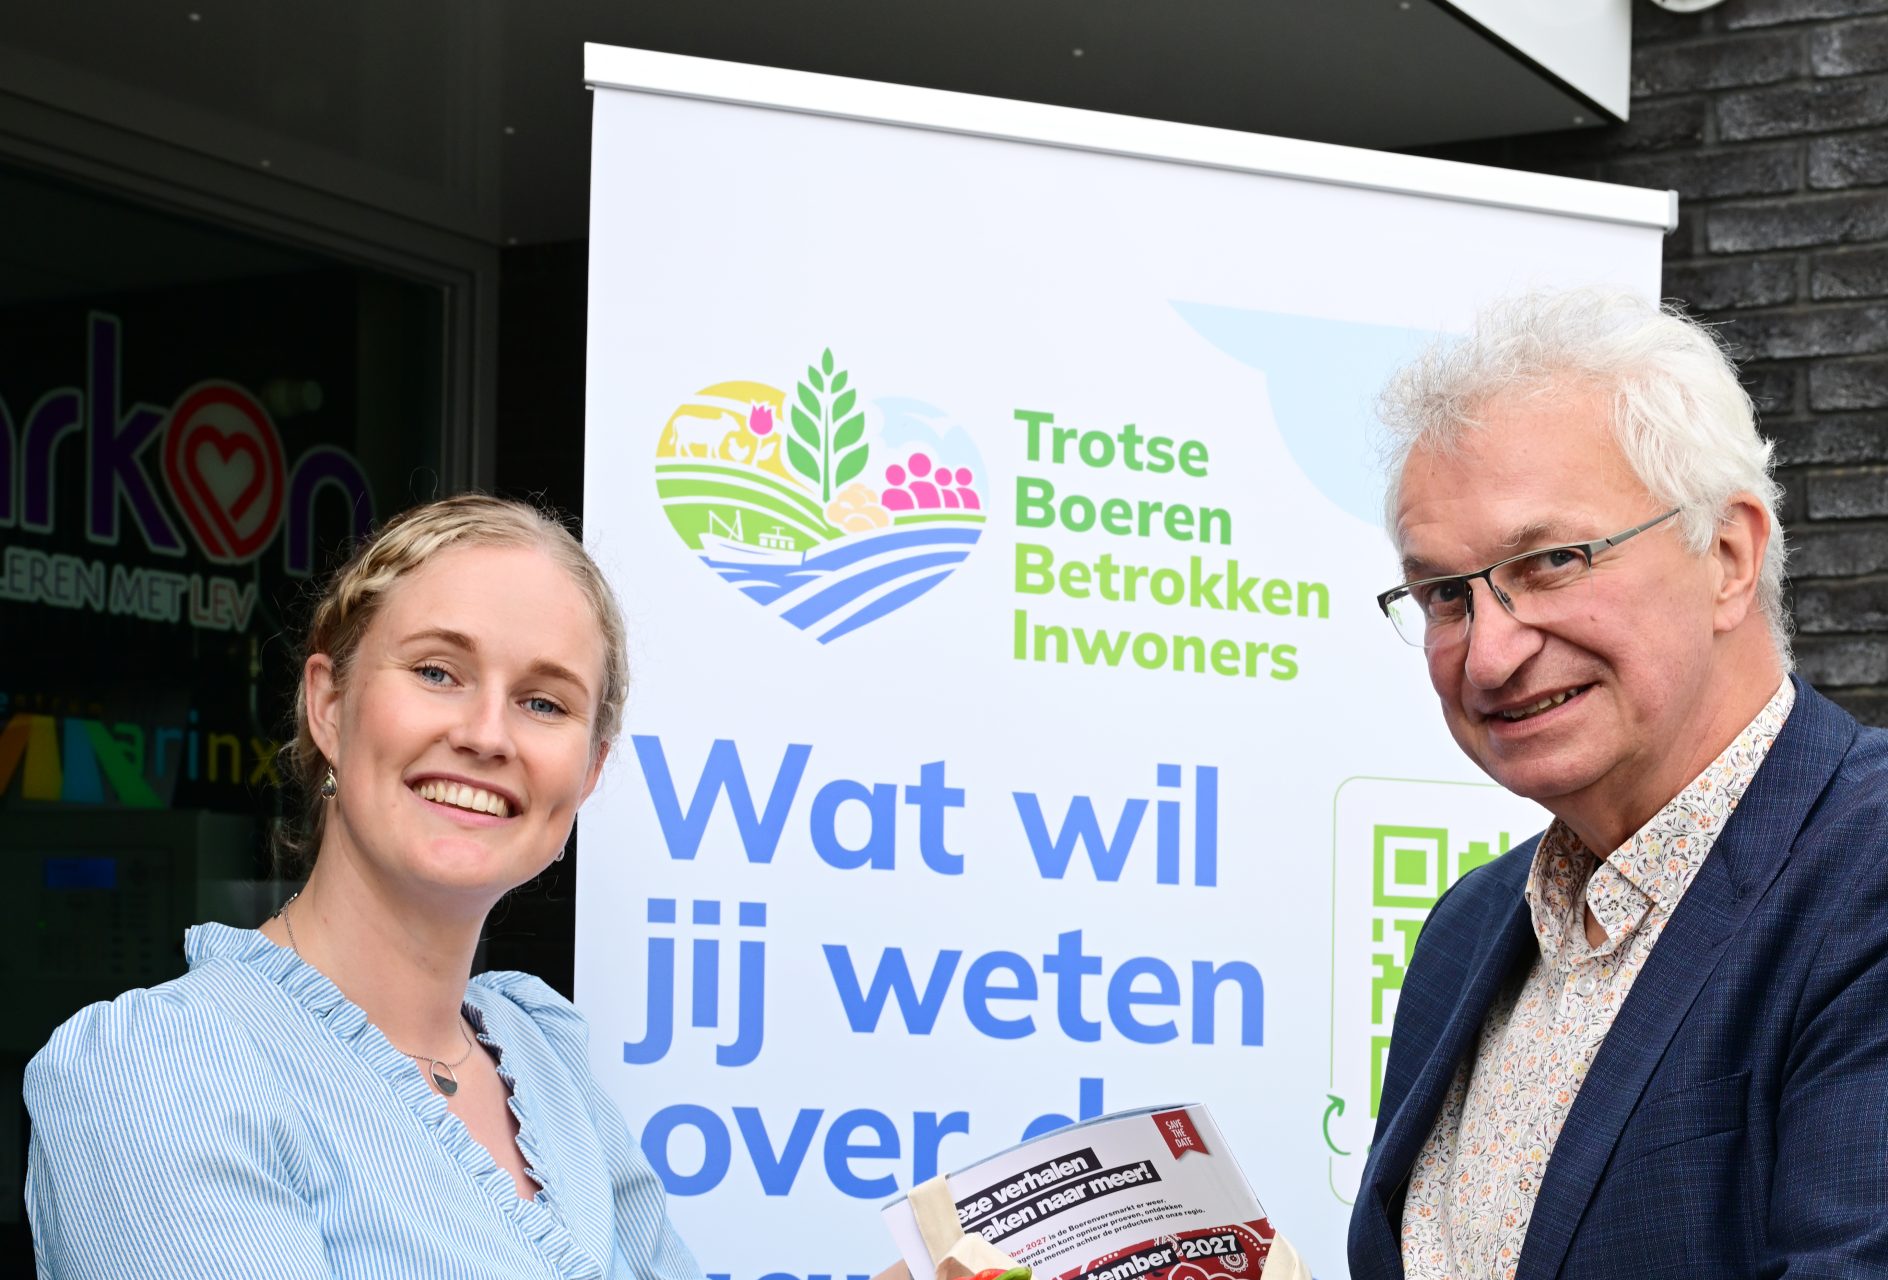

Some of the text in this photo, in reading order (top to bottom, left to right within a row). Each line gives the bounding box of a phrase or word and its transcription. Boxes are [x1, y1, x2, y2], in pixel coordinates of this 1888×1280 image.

[1015, 411, 1208, 477] Trotse
[1015, 477, 1231, 545] Boeren
[0, 550, 256, 630] EREN MET LEV
[1015, 544, 1329, 619] Betrokken
[1014, 609, 1298, 681] Inwoners
[632, 735, 1218, 887] Wat wil
[624, 898, 1264, 1067] jij weten
[640, 1104, 970, 1200] over
[1165, 1119, 1184, 1130] SAVE
[1171, 1128, 1187, 1138] THE
[1175, 1136, 1194, 1148] DATE
[957, 1156, 1089, 1223] eze verhalen
[981, 1162, 1153, 1241] aken naar meer!
[1009, 1248, 1024, 1259] ber
[1026, 1236, 1047, 1251] 2027
[1048, 1233, 1056, 1241] is
[1057, 1228, 1067, 1237] de
[1068, 1204, 1136, 1231] Boerenversmarkt
[1146, 1199, 1167, 1207] weer.
[1033, 1258, 1045, 1267] de
[1044, 1245, 1075, 1261] mensen
[1076, 1235, 1101, 1247] achter
[1103, 1229, 1113, 1237] de
[1114, 1217, 1153, 1234] producten
[1154, 1213, 1164, 1221] uit
[1165, 1211, 1183, 1219] onze
[1184, 1208, 1206, 1216] regio.
[1057, 1235, 1075, 1246] kom
[1076, 1223, 1109, 1241] opnieuw
[1110, 1211, 1144, 1226] proeven,
[1144, 1203, 1183, 1215] ontdekken
[1181, 1234, 1238, 1259] 2027
